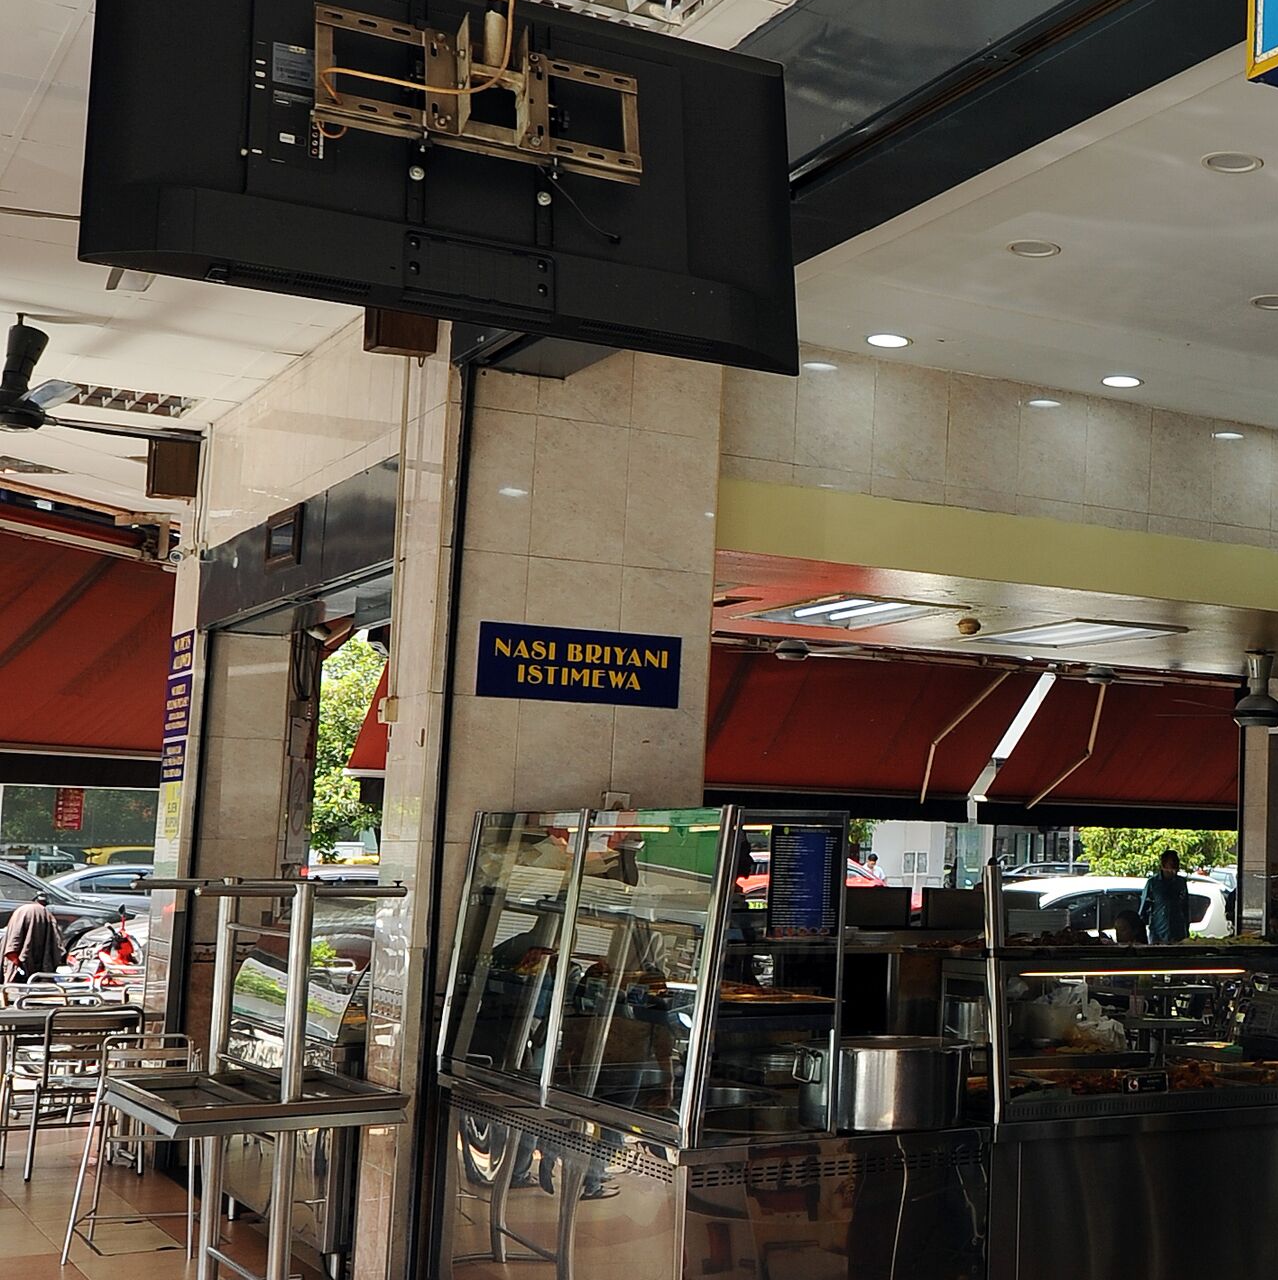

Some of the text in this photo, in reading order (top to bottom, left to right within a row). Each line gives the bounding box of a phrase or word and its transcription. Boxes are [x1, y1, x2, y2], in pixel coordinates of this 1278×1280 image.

[496, 637, 668, 669] NASI BRIYANI
[517, 664, 641, 691] ISTIMEWA
